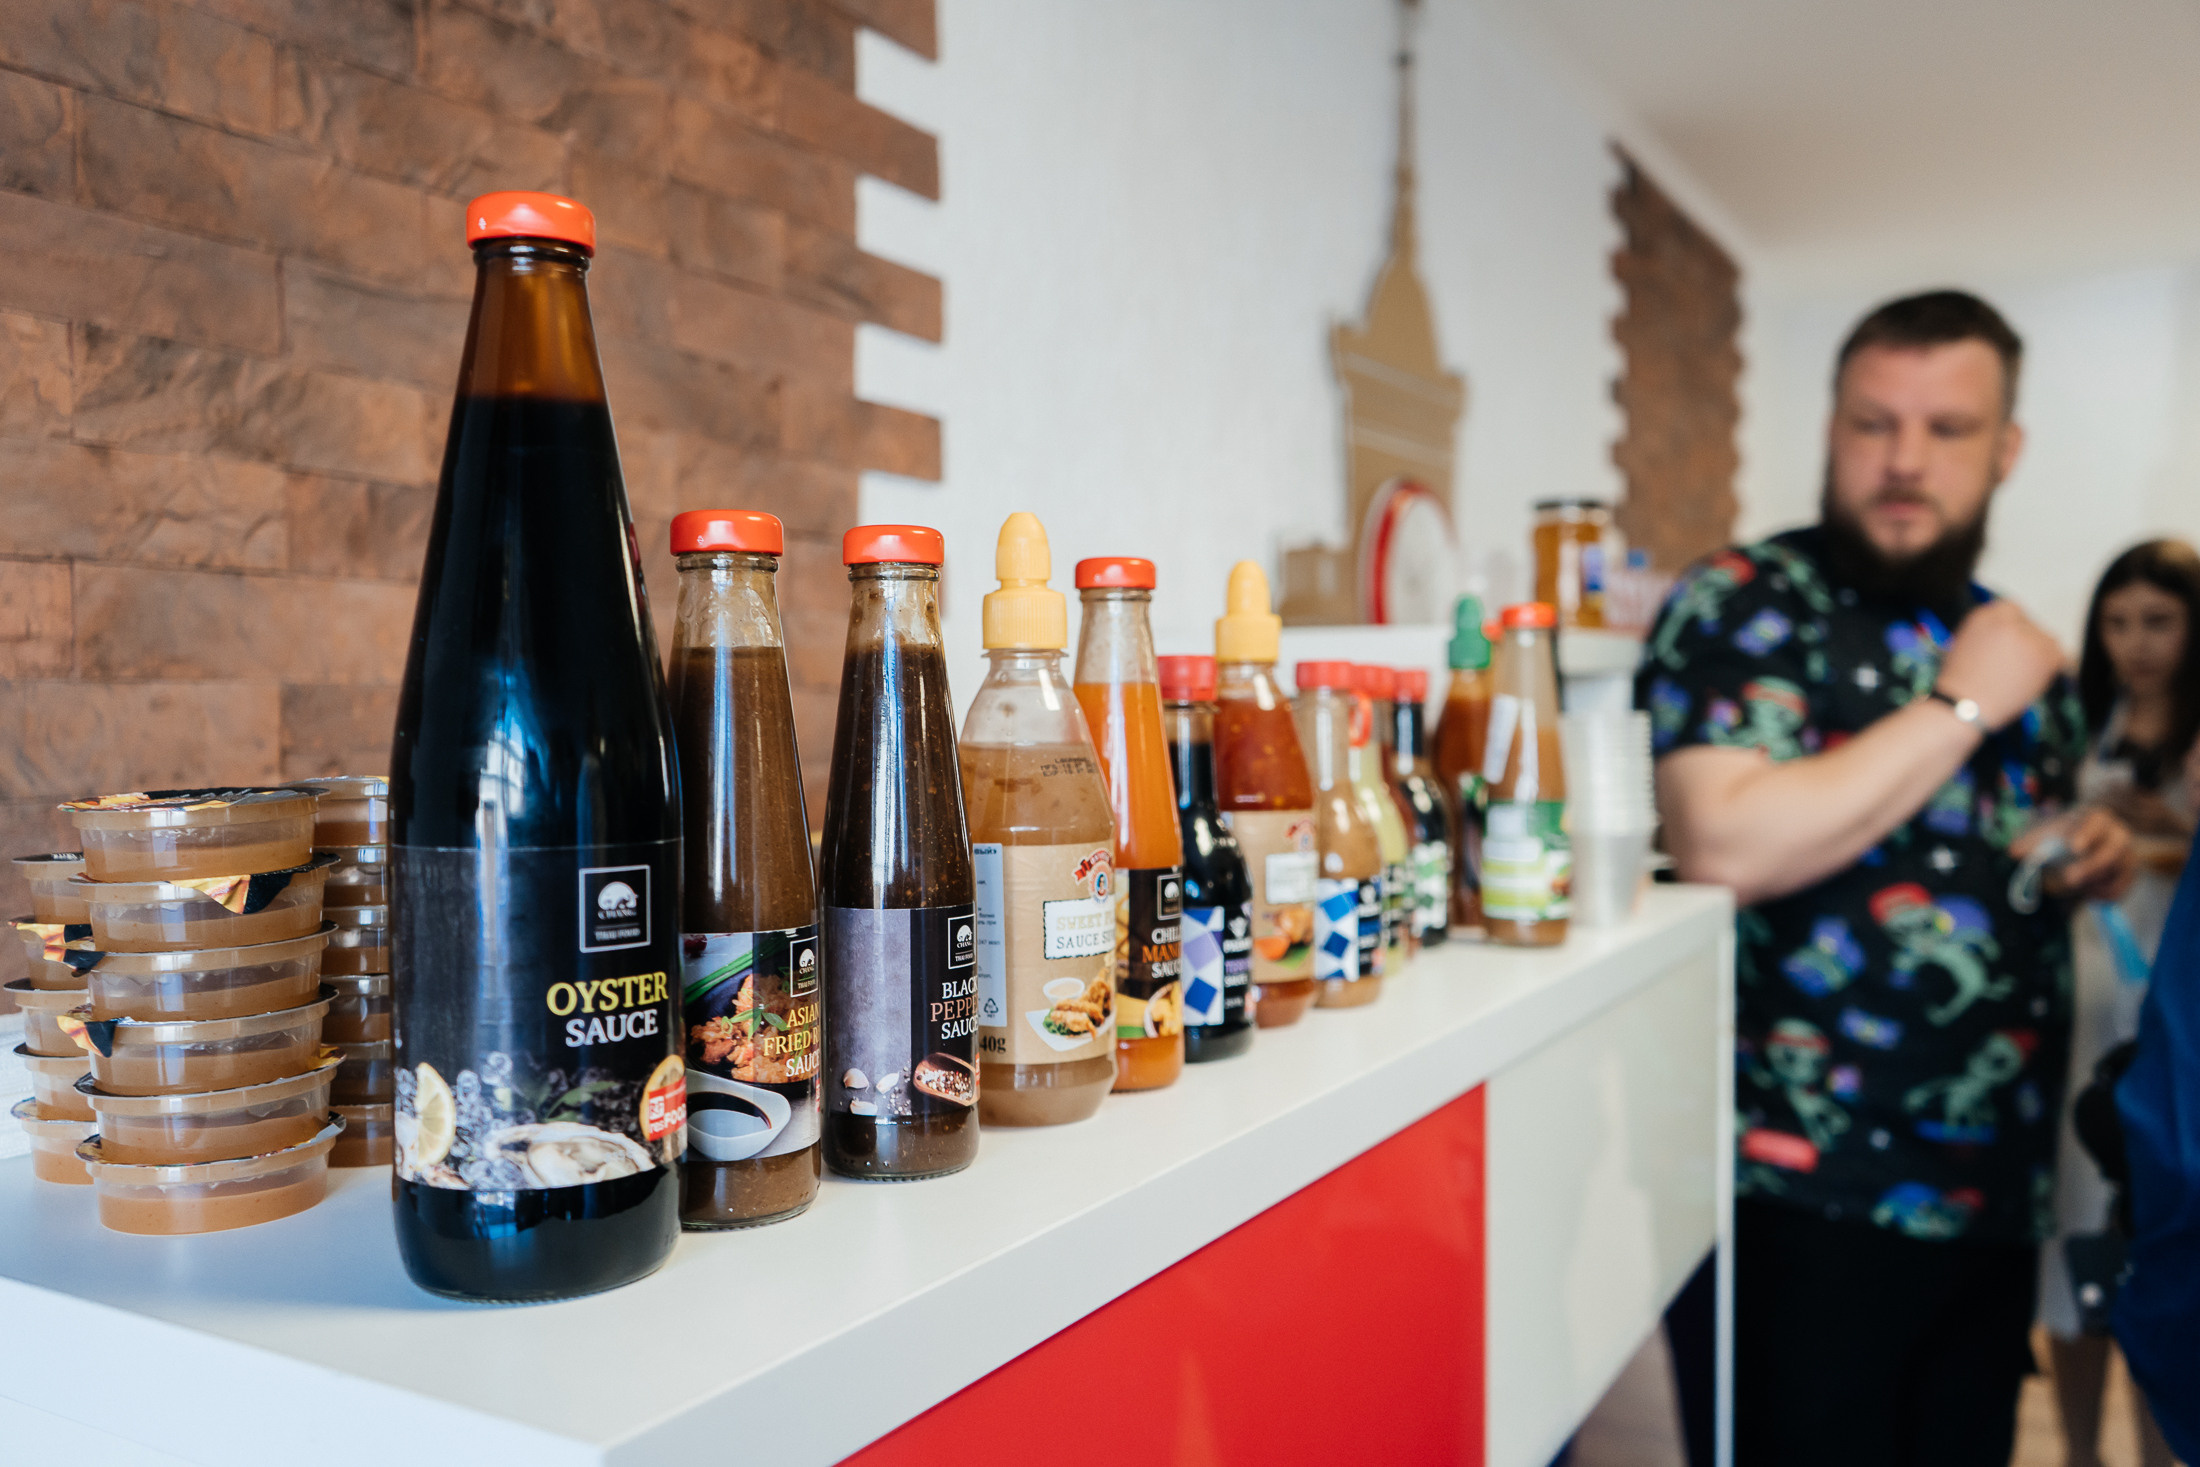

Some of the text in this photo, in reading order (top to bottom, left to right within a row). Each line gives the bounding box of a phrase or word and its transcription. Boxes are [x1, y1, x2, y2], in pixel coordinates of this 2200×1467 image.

[1057, 912, 1102, 931] SWEET
[1057, 933, 1099, 949] SAUCE
[1151, 925, 1180, 944] CHIL
[1142, 943, 1180, 963] MAN
[1151, 959, 1180, 978] SAUC
[546, 971, 669, 1017] OYSTER
[941, 975, 978, 999] BLACK
[786, 1003, 819, 1028] ASIAN
[930, 993, 979, 1022] PEPPE
[565, 1009, 659, 1048] SAUCE
[941, 1015, 979, 1040] SAUCE
[764, 1030, 811, 1056] FRIED
